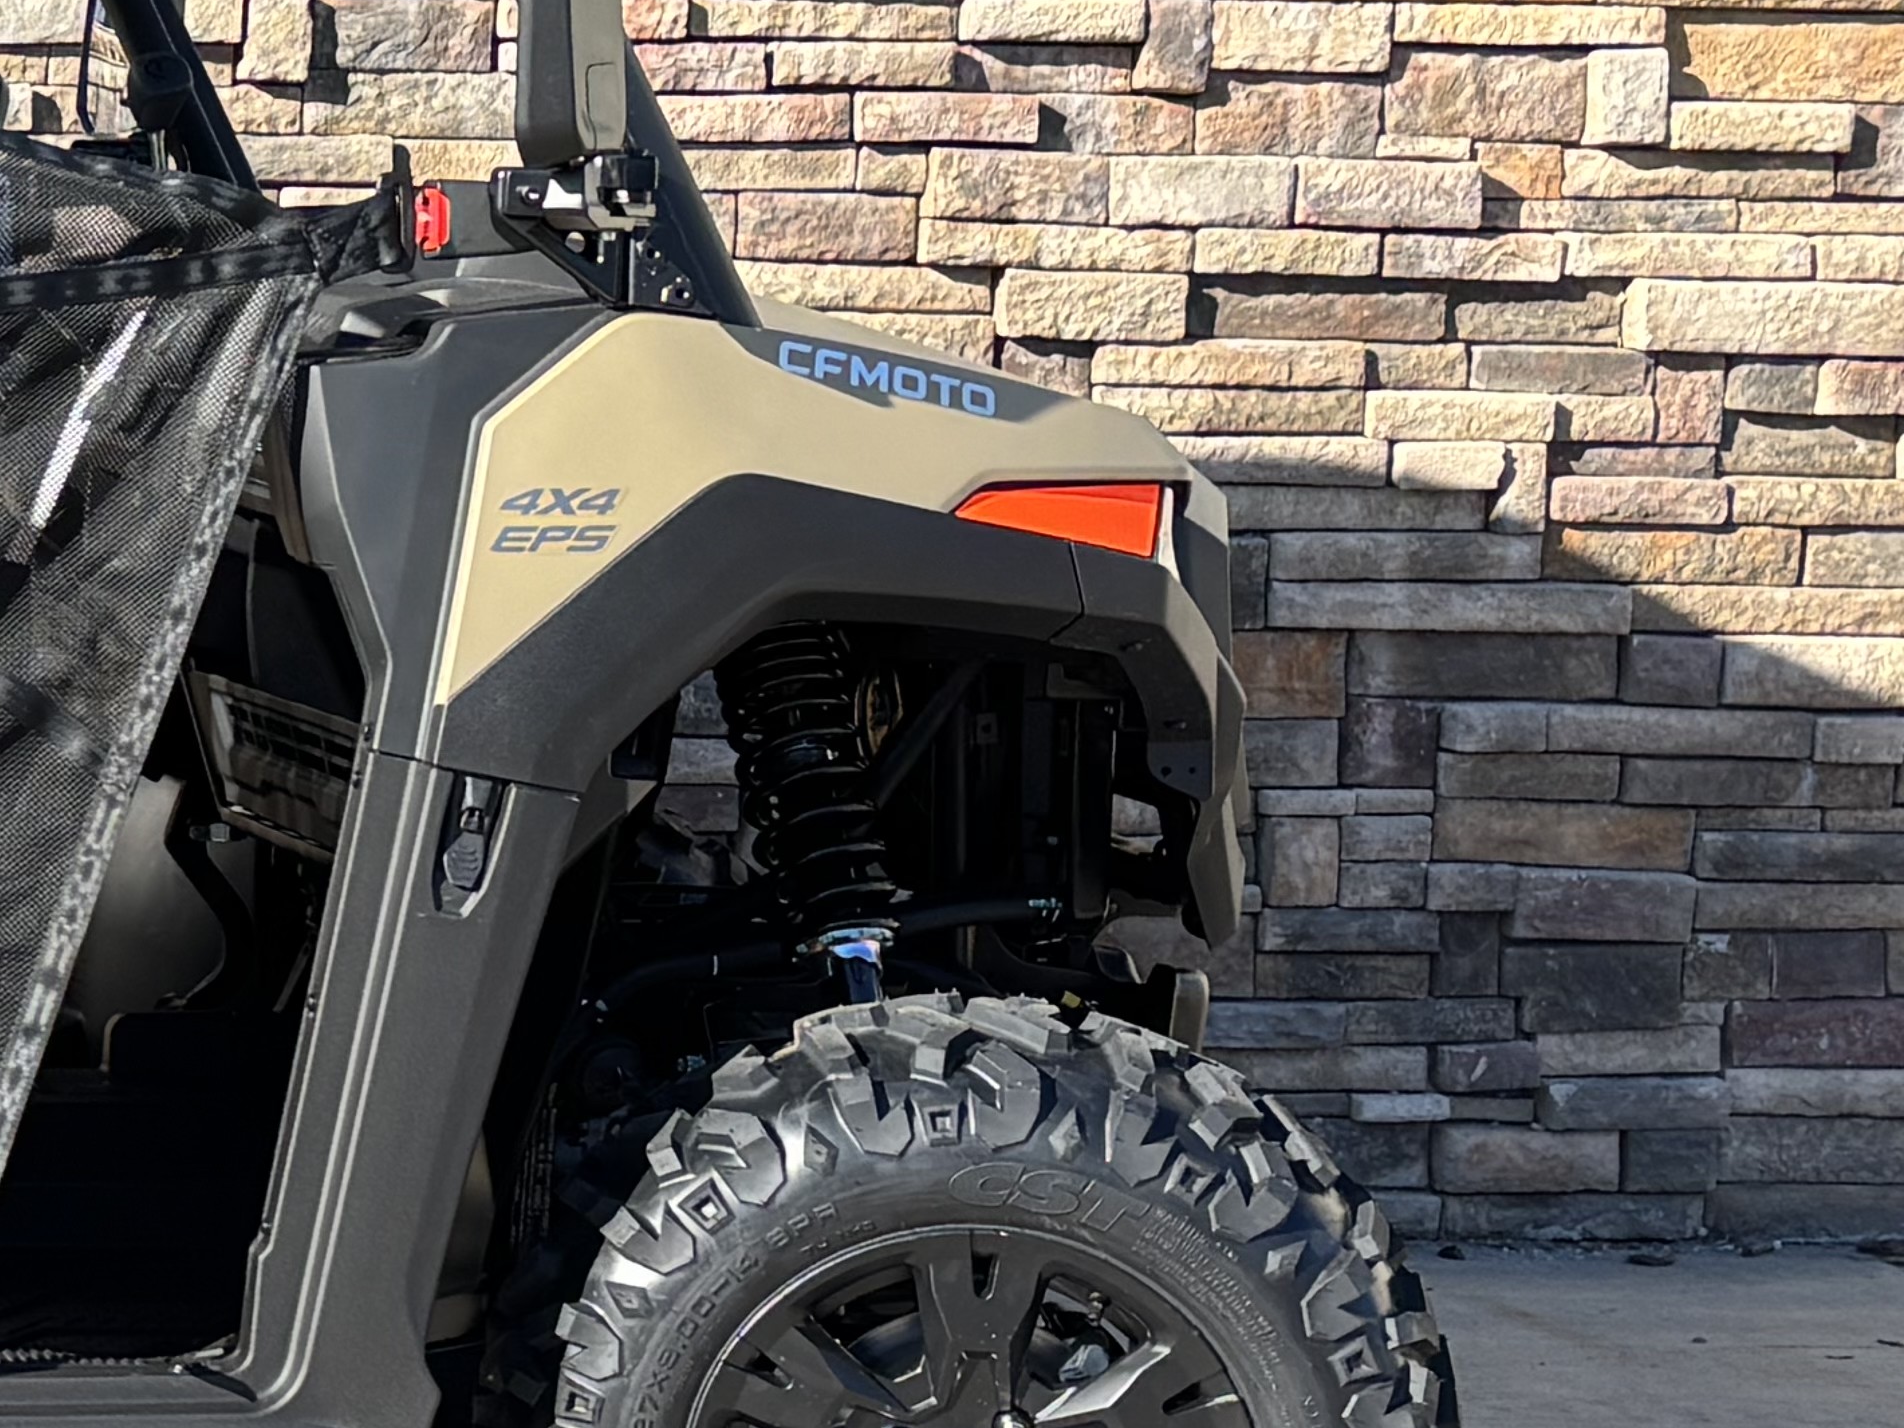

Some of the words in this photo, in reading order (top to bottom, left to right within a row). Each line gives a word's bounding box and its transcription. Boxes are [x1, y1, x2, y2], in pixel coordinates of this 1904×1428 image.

[779, 340, 996, 417] CFMOTO
[499, 487, 621, 515] 4X4
[490, 524, 617, 553] EPS
[948, 1161, 1152, 1232] CST
